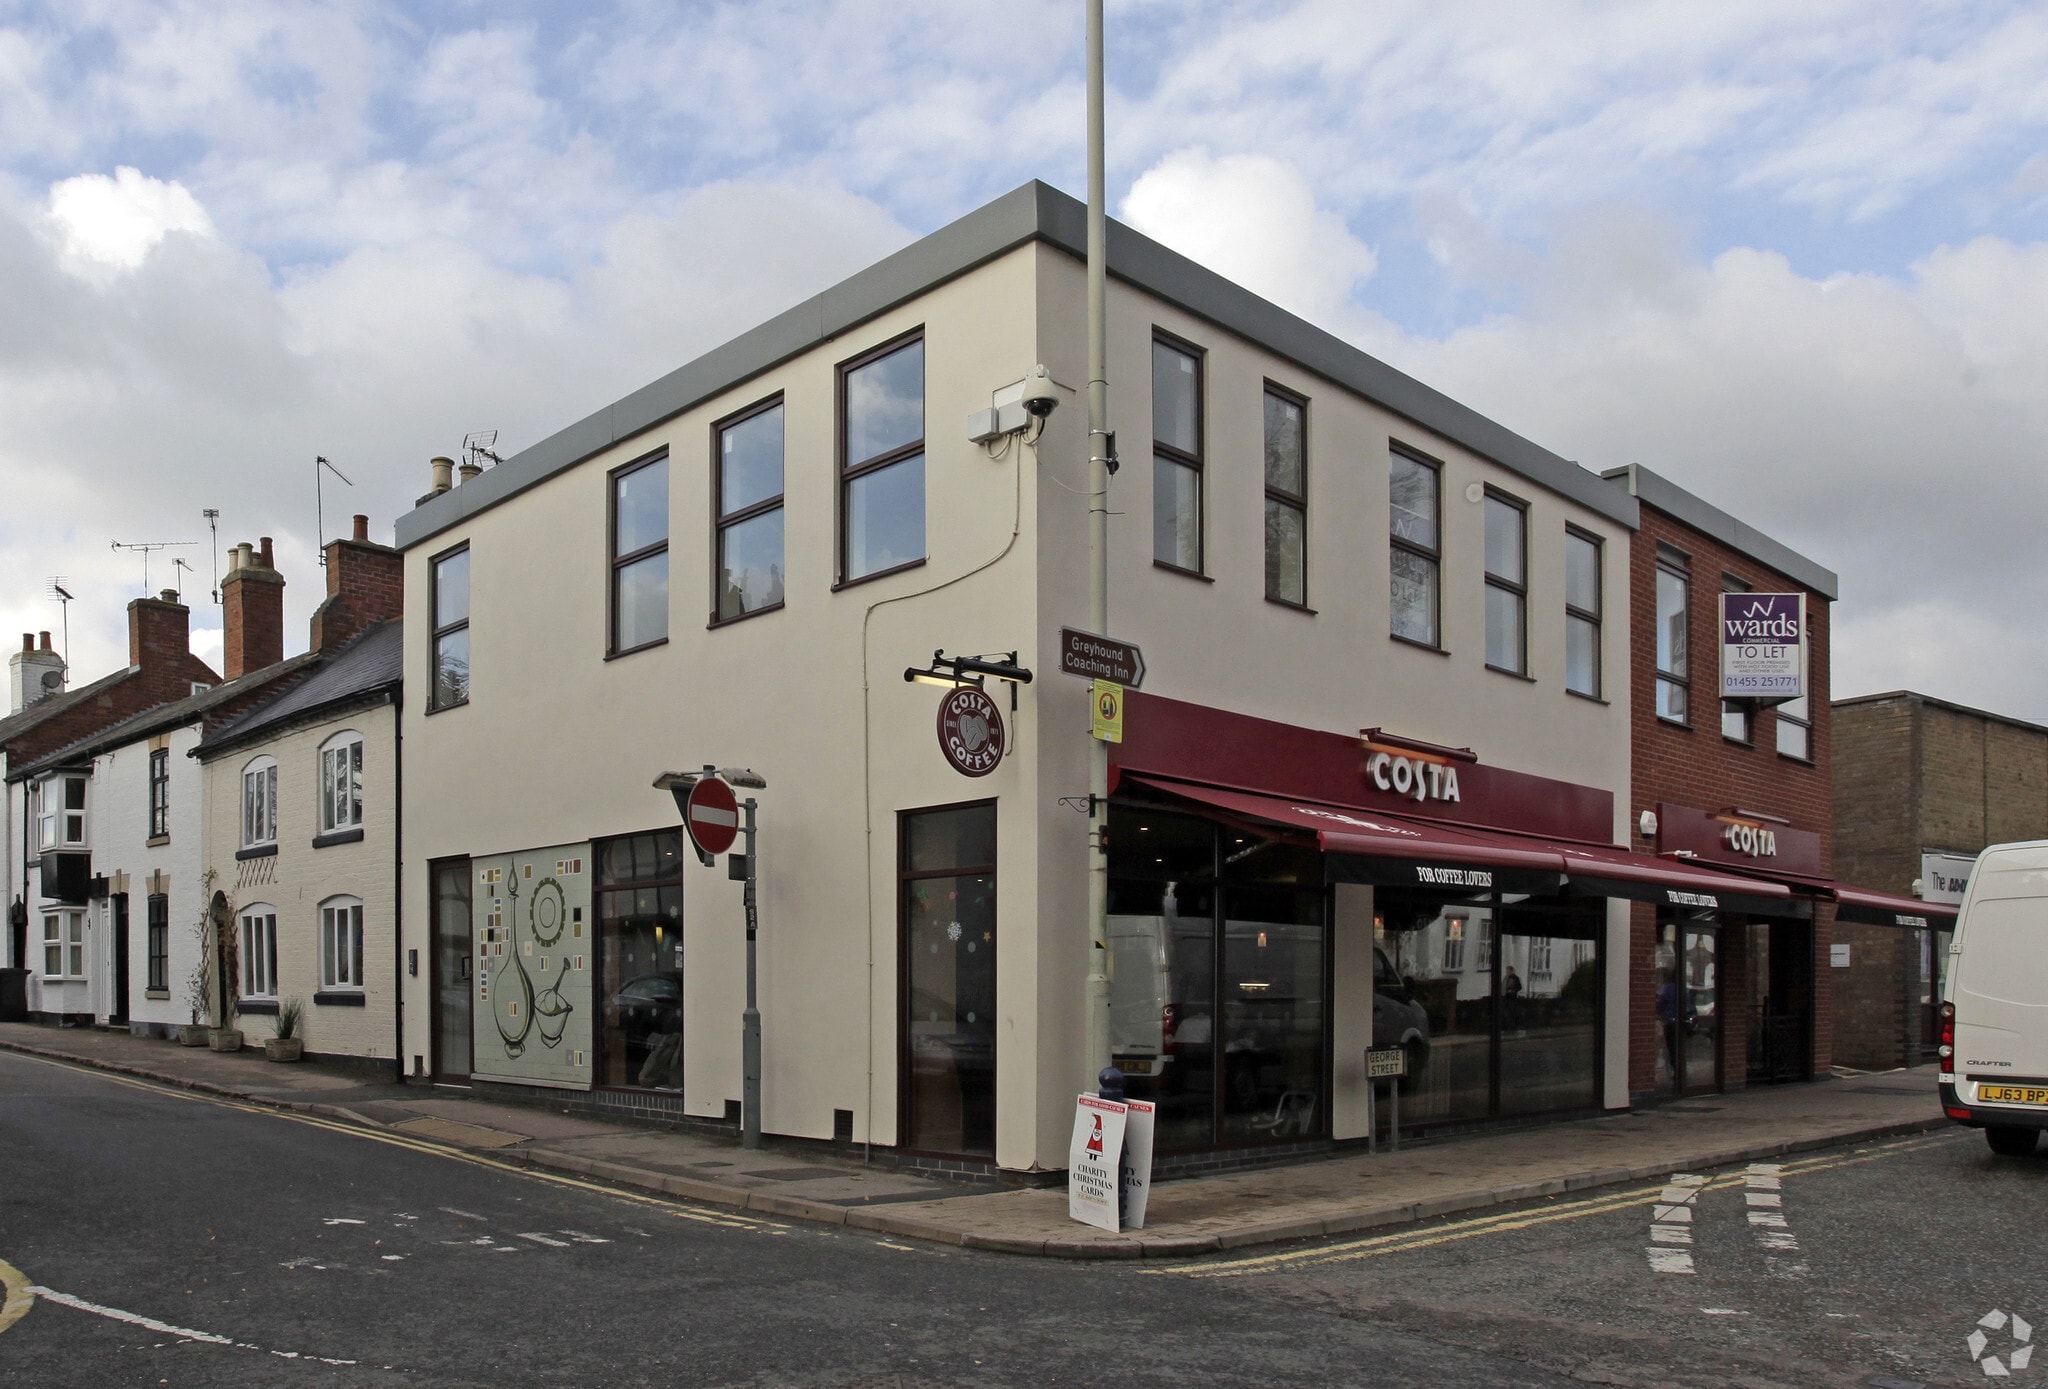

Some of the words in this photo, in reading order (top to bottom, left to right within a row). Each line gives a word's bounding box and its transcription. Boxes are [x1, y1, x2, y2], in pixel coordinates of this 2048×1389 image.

[1725, 612, 1798, 637] wards
[1071, 636, 1123, 661] Greyhound
[1736, 646, 1757, 658] TO
[1763, 646, 1787, 658] LET
[1065, 652, 1112, 678] Coaching
[1114, 664, 1129, 679] Inn
[1726, 677, 1757, 686] 01455
[1761, 677, 1797, 686] 251771
[951, 694, 992, 720] COSTA
[950, 736, 998, 769] COFFEE
[1370, 752, 1460, 802] COSTA
[1730, 824, 1776, 857] COSTA
[1416, 867, 1434, 882] FOR
[1435, 868, 1463, 885] COFFEE
[1464, 870, 1492, 887] LOVERS
[1932, 872, 1945, 891] The
[1370, 1051, 1400, 1063] GEORGE
[1371, 1063, 1399, 1075] STREET
[1984, 1088, 2022, 1101] LJ63
[1073, 1172, 1113, 1190] CHRISTMAS
[1078, 1164, 1108, 1179] CHARITY
[1081, 1186, 1104, 1198] CARDS
